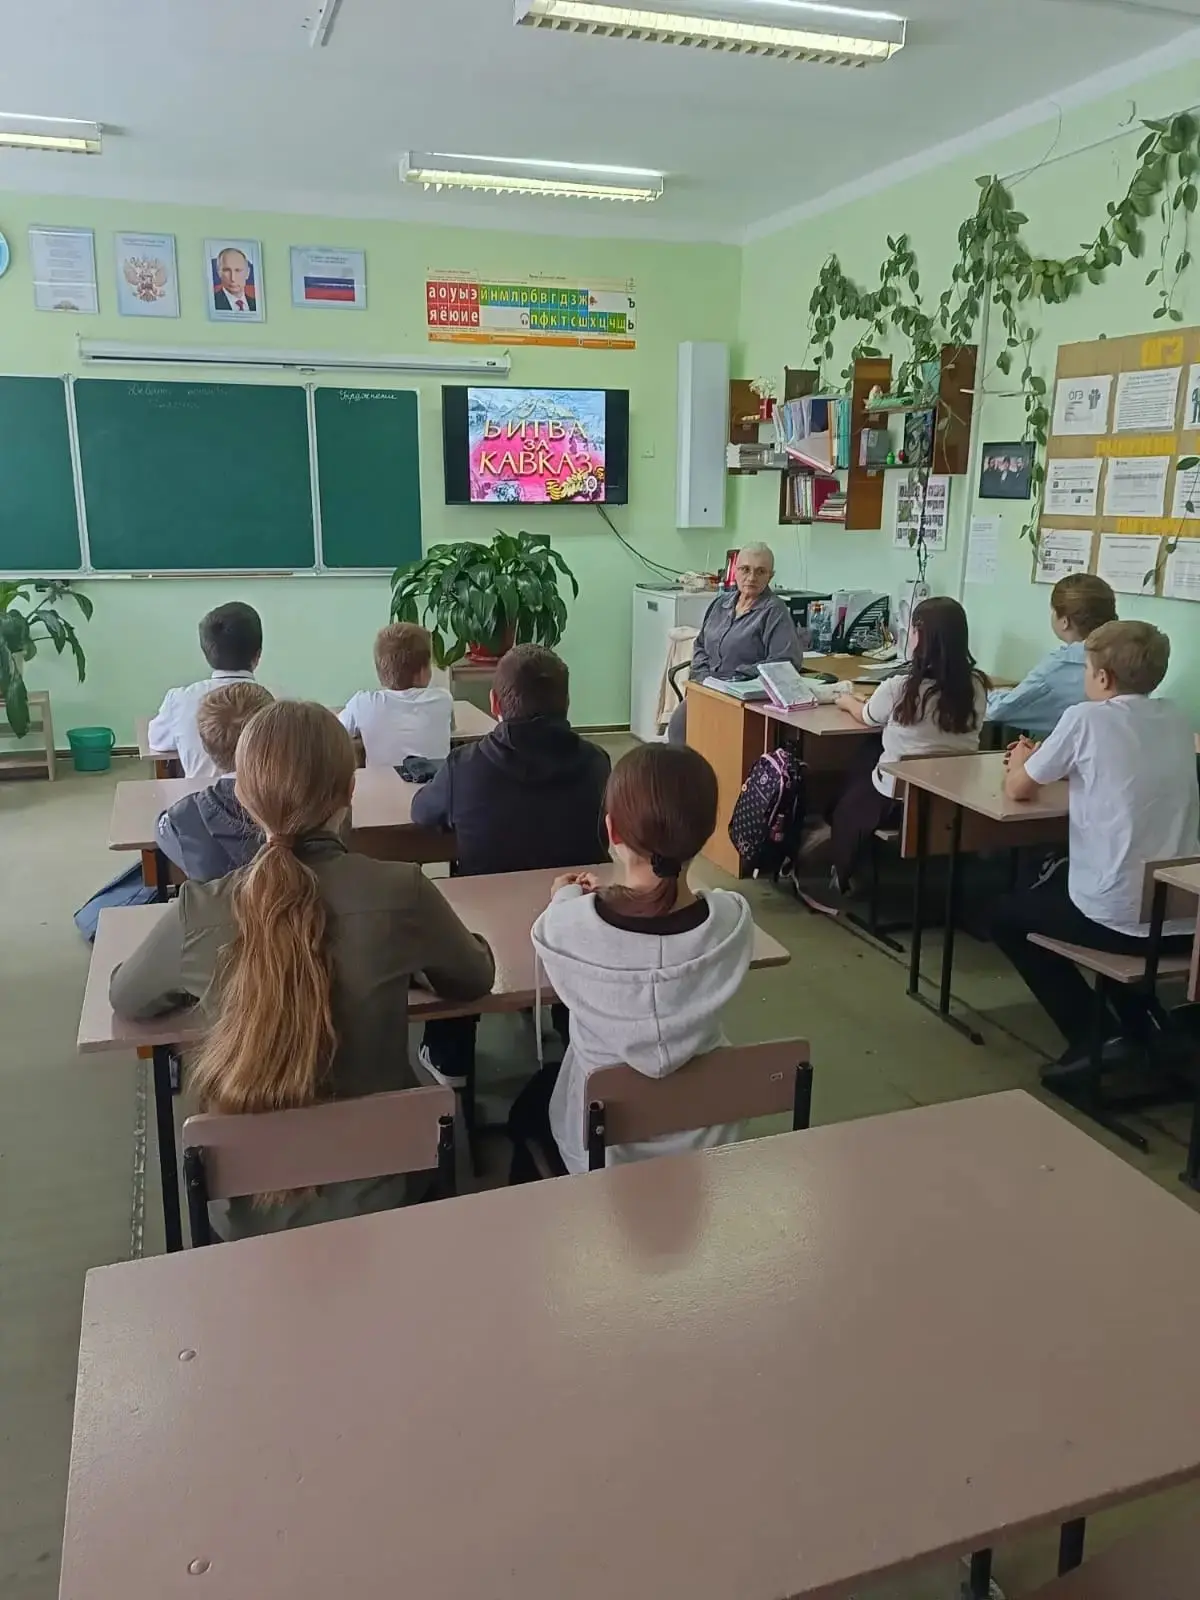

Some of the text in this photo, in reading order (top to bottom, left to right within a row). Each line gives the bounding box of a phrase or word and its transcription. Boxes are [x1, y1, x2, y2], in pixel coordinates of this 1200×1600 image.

[483, 419, 588, 440] БИТВА
[522, 439, 550, 451] ЗА
[479, 450, 593, 475] КАВКАЗ
